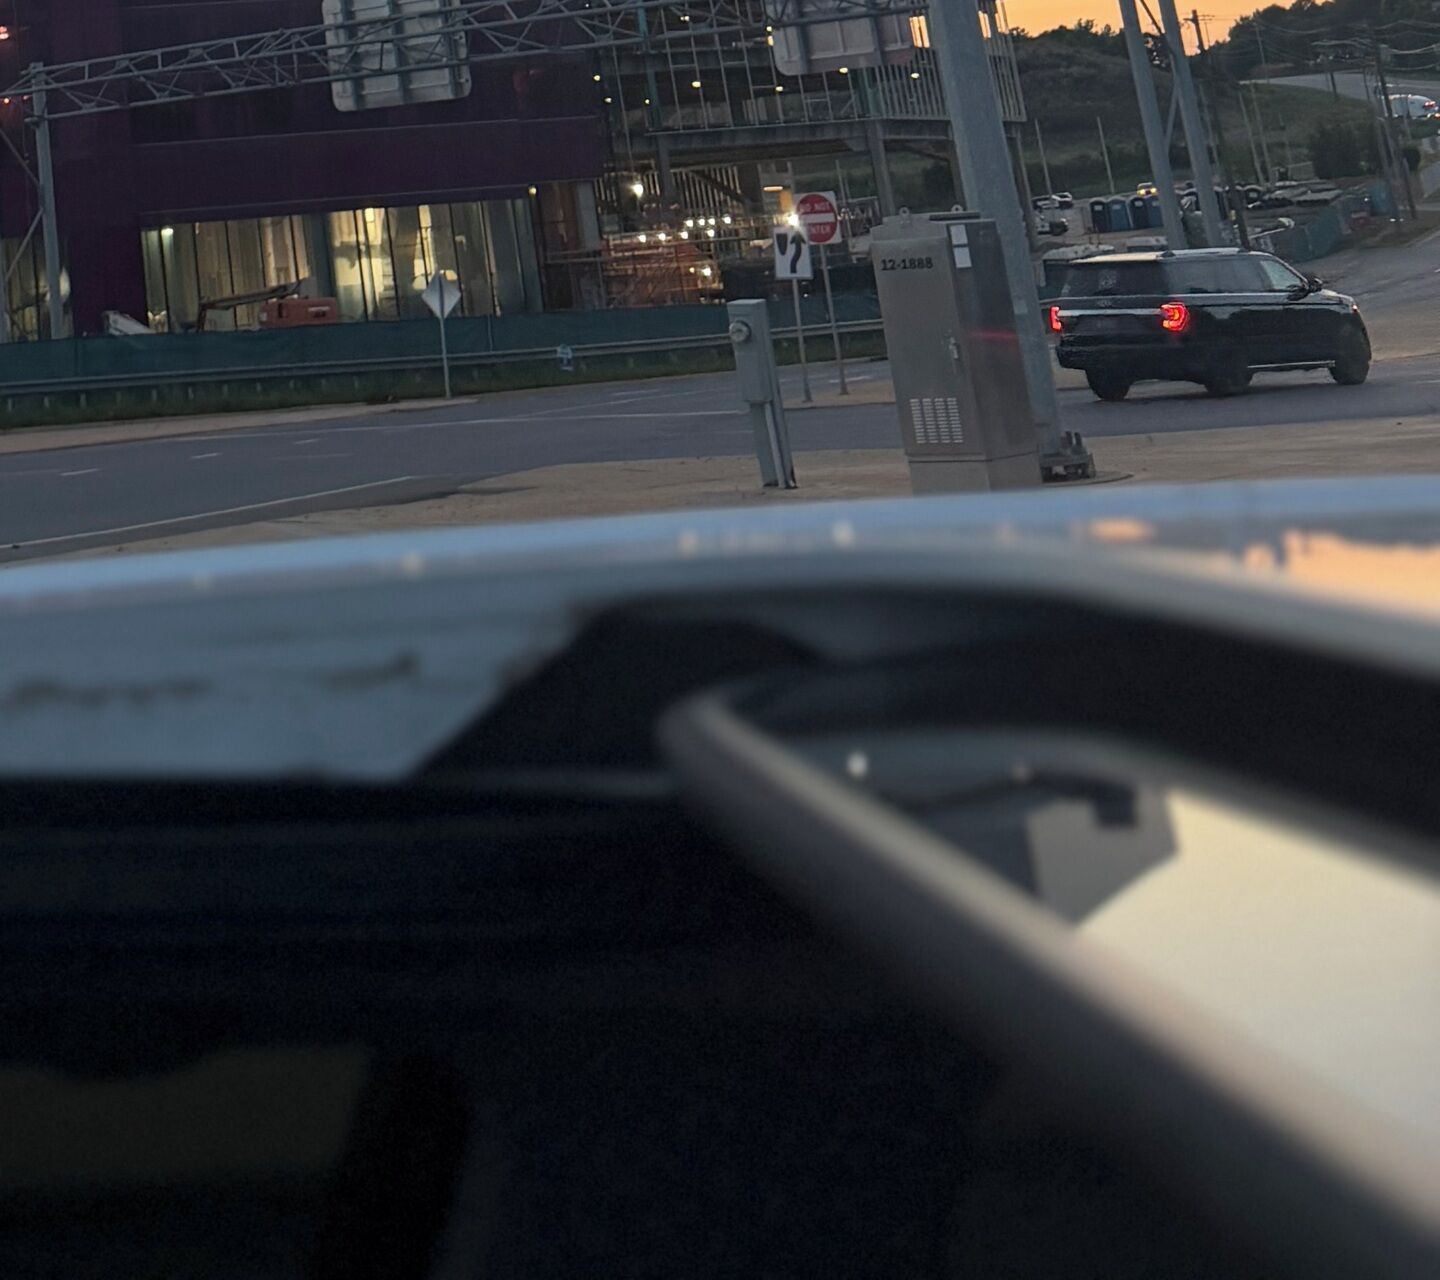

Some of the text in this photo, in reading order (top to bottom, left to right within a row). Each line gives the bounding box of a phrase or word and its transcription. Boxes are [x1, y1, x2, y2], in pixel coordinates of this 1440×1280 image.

[800, 201, 830, 212] DO NOT
[881, 257, 934, 271] 12-1888
